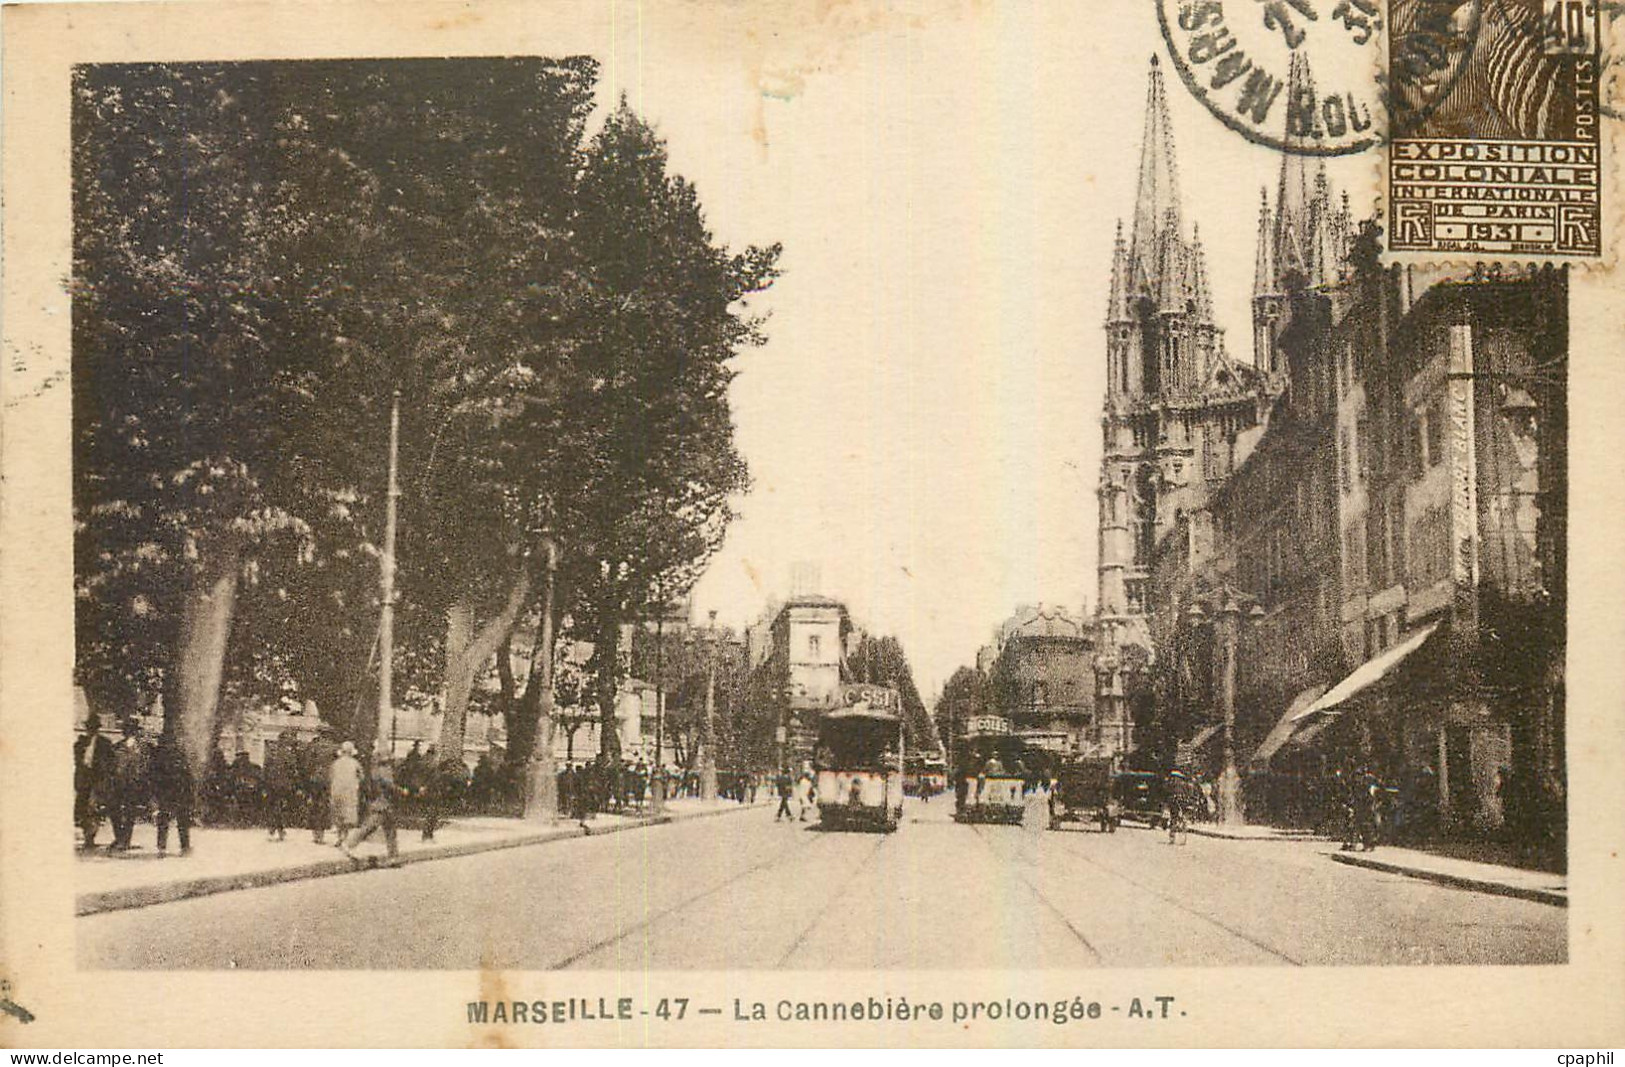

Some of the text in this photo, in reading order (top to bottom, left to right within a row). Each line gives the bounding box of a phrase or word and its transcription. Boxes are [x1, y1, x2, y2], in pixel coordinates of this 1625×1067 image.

[1575, 60, 1595, 139] POSTES
[1394, 144, 1594, 163] EXPOSITION
[1395, 165, 1593, 184] COLONIALE
[1394, 185, 1594, 201] INTERNATIONALE
[1436, 204, 1552, 219] DE PARIS
[1467, 223, 1521, 240] 1931
